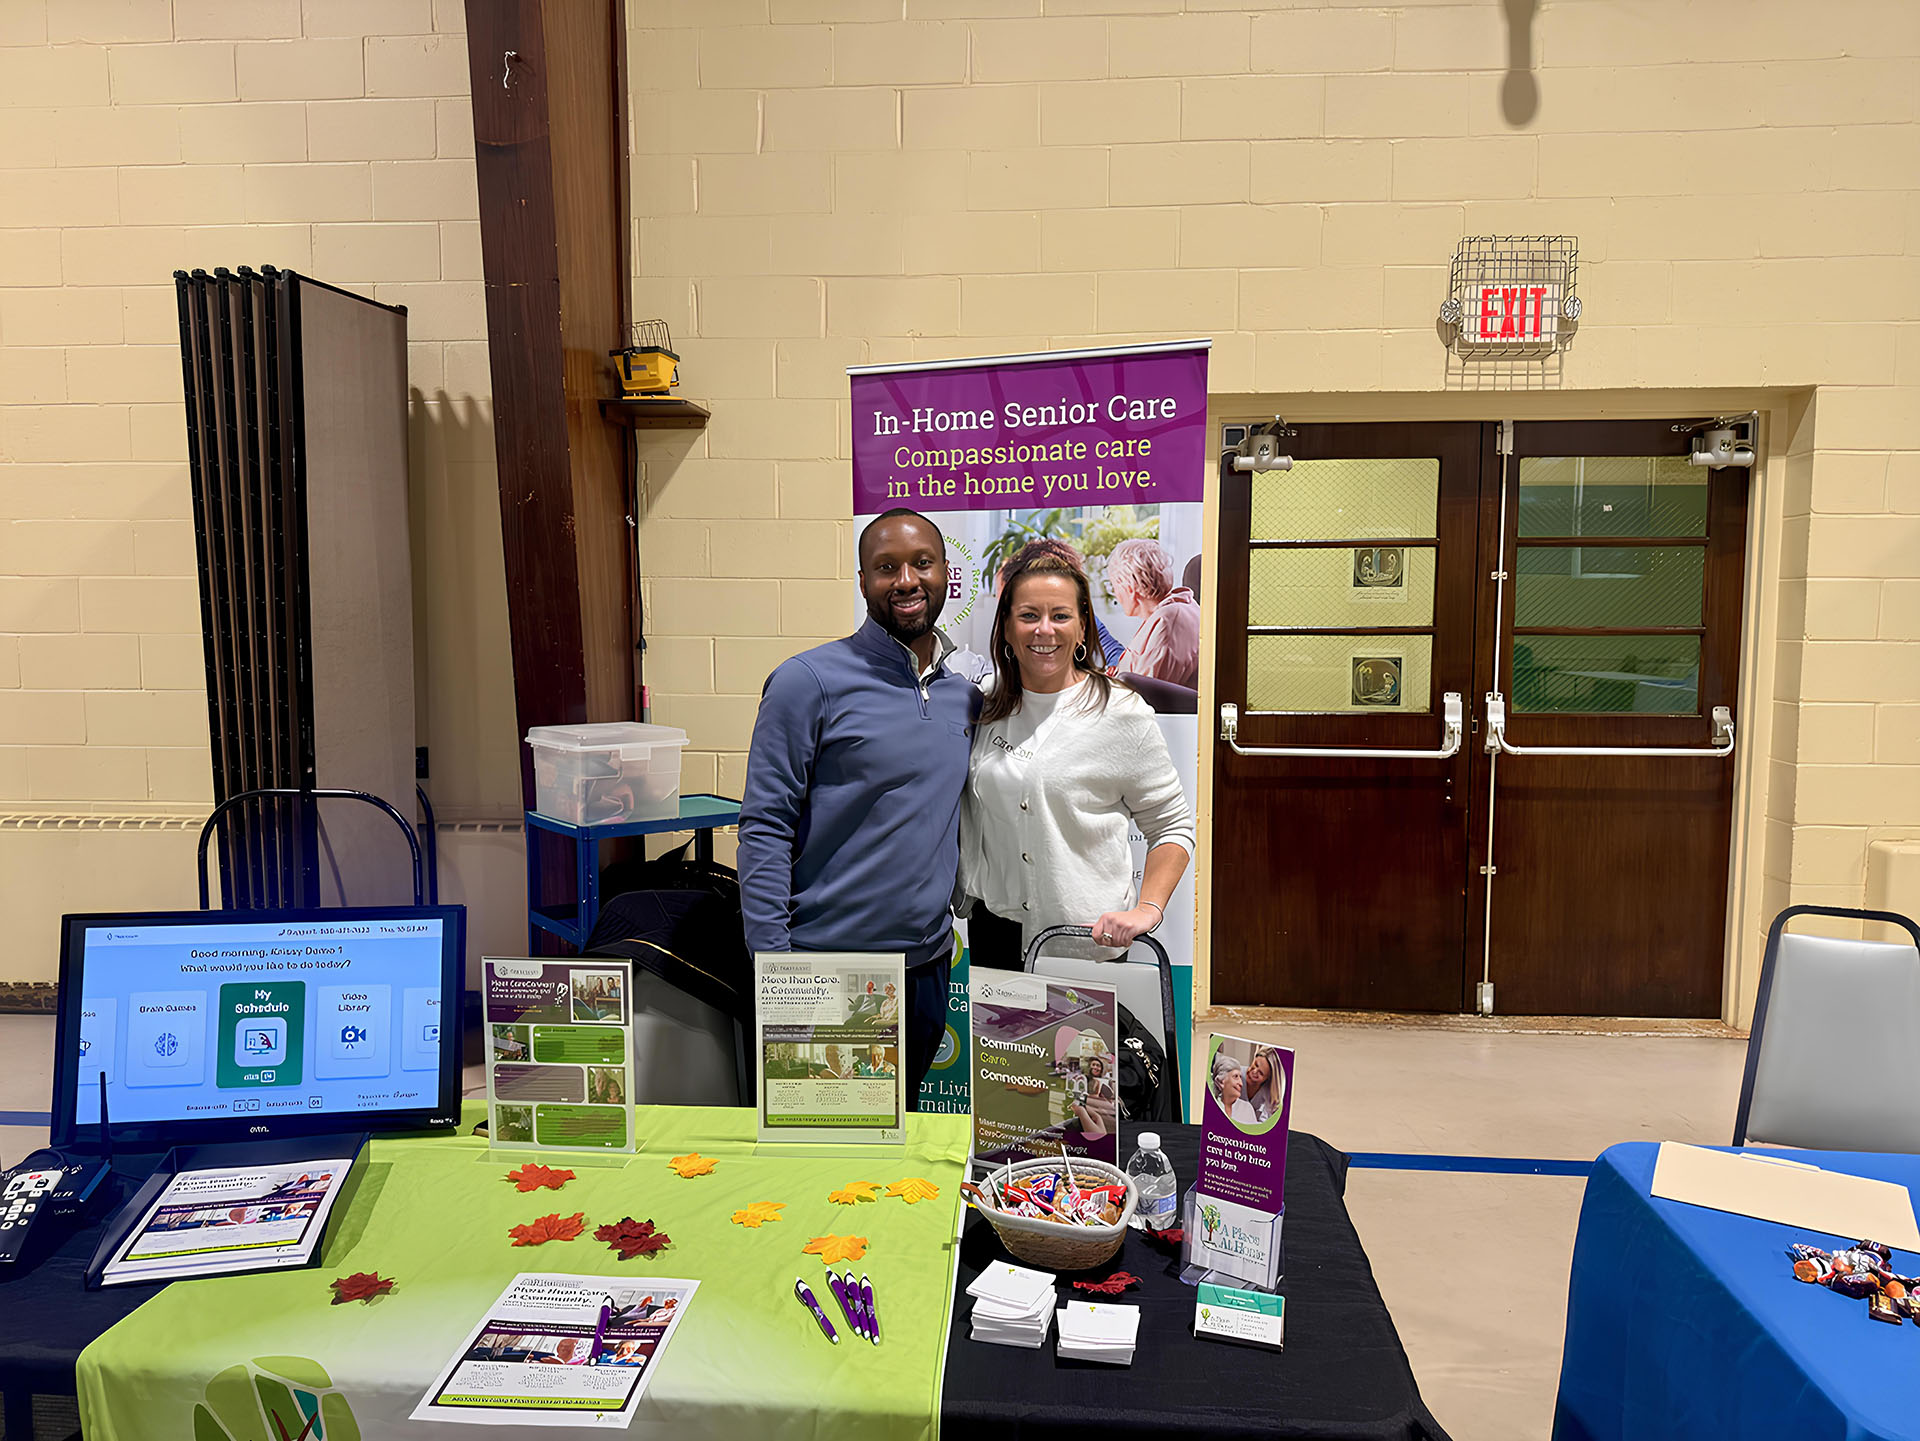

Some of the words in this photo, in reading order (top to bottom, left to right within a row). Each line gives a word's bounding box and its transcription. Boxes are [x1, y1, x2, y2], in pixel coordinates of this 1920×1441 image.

[1480, 288, 1547, 338] EXIT
[873, 407, 995, 436] In-Home
[1004, 400, 1099, 430] Senior
[1107, 395, 1177, 422] Care
[894, 439, 1087, 471] Compassionate
[1095, 438, 1152, 461] care
[887, 476, 911, 498] in
[917, 473, 956, 496] the
[964, 471, 1035, 495] home
[1042, 470, 1089, 498] you
[1096, 466, 1157, 490] love.
[255, 989, 272, 1001] My
[980, 1036, 1049, 1058] Community.
[980, 1051, 1010, 1066] Care.
[980, 1068, 1049, 1089] Connection.
